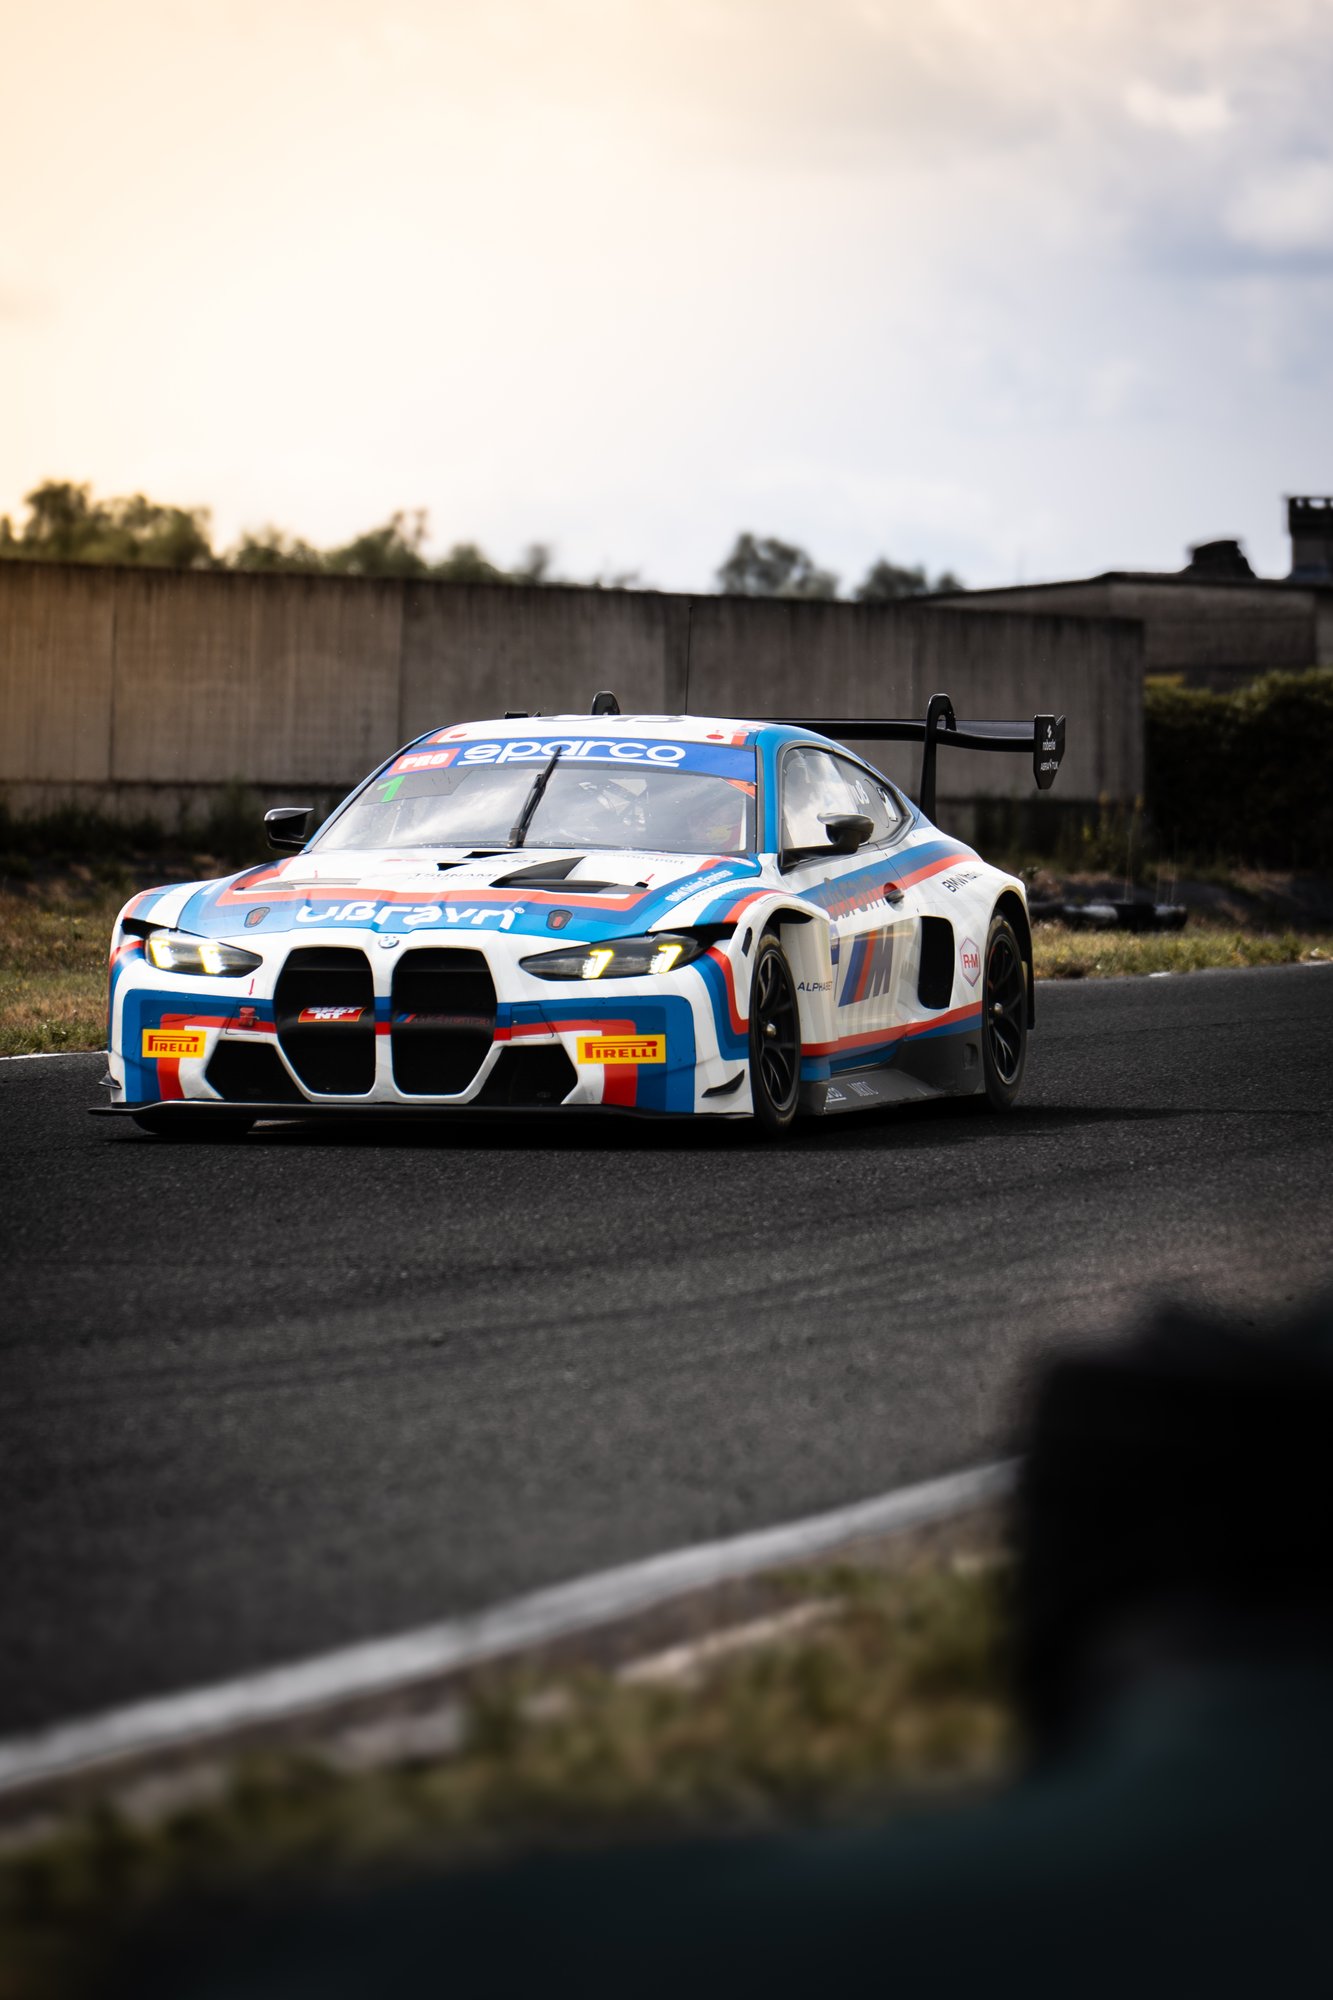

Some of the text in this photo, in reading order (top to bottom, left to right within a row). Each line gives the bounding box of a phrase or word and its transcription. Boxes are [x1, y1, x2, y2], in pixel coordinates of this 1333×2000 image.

[462, 737, 686, 764] sparco
[398, 752, 449, 770] PRO
[377, 775, 405, 802] 1
[147, 1035, 200, 1052] PIRELLI
[584, 1041, 658, 1059] PIRELLI
